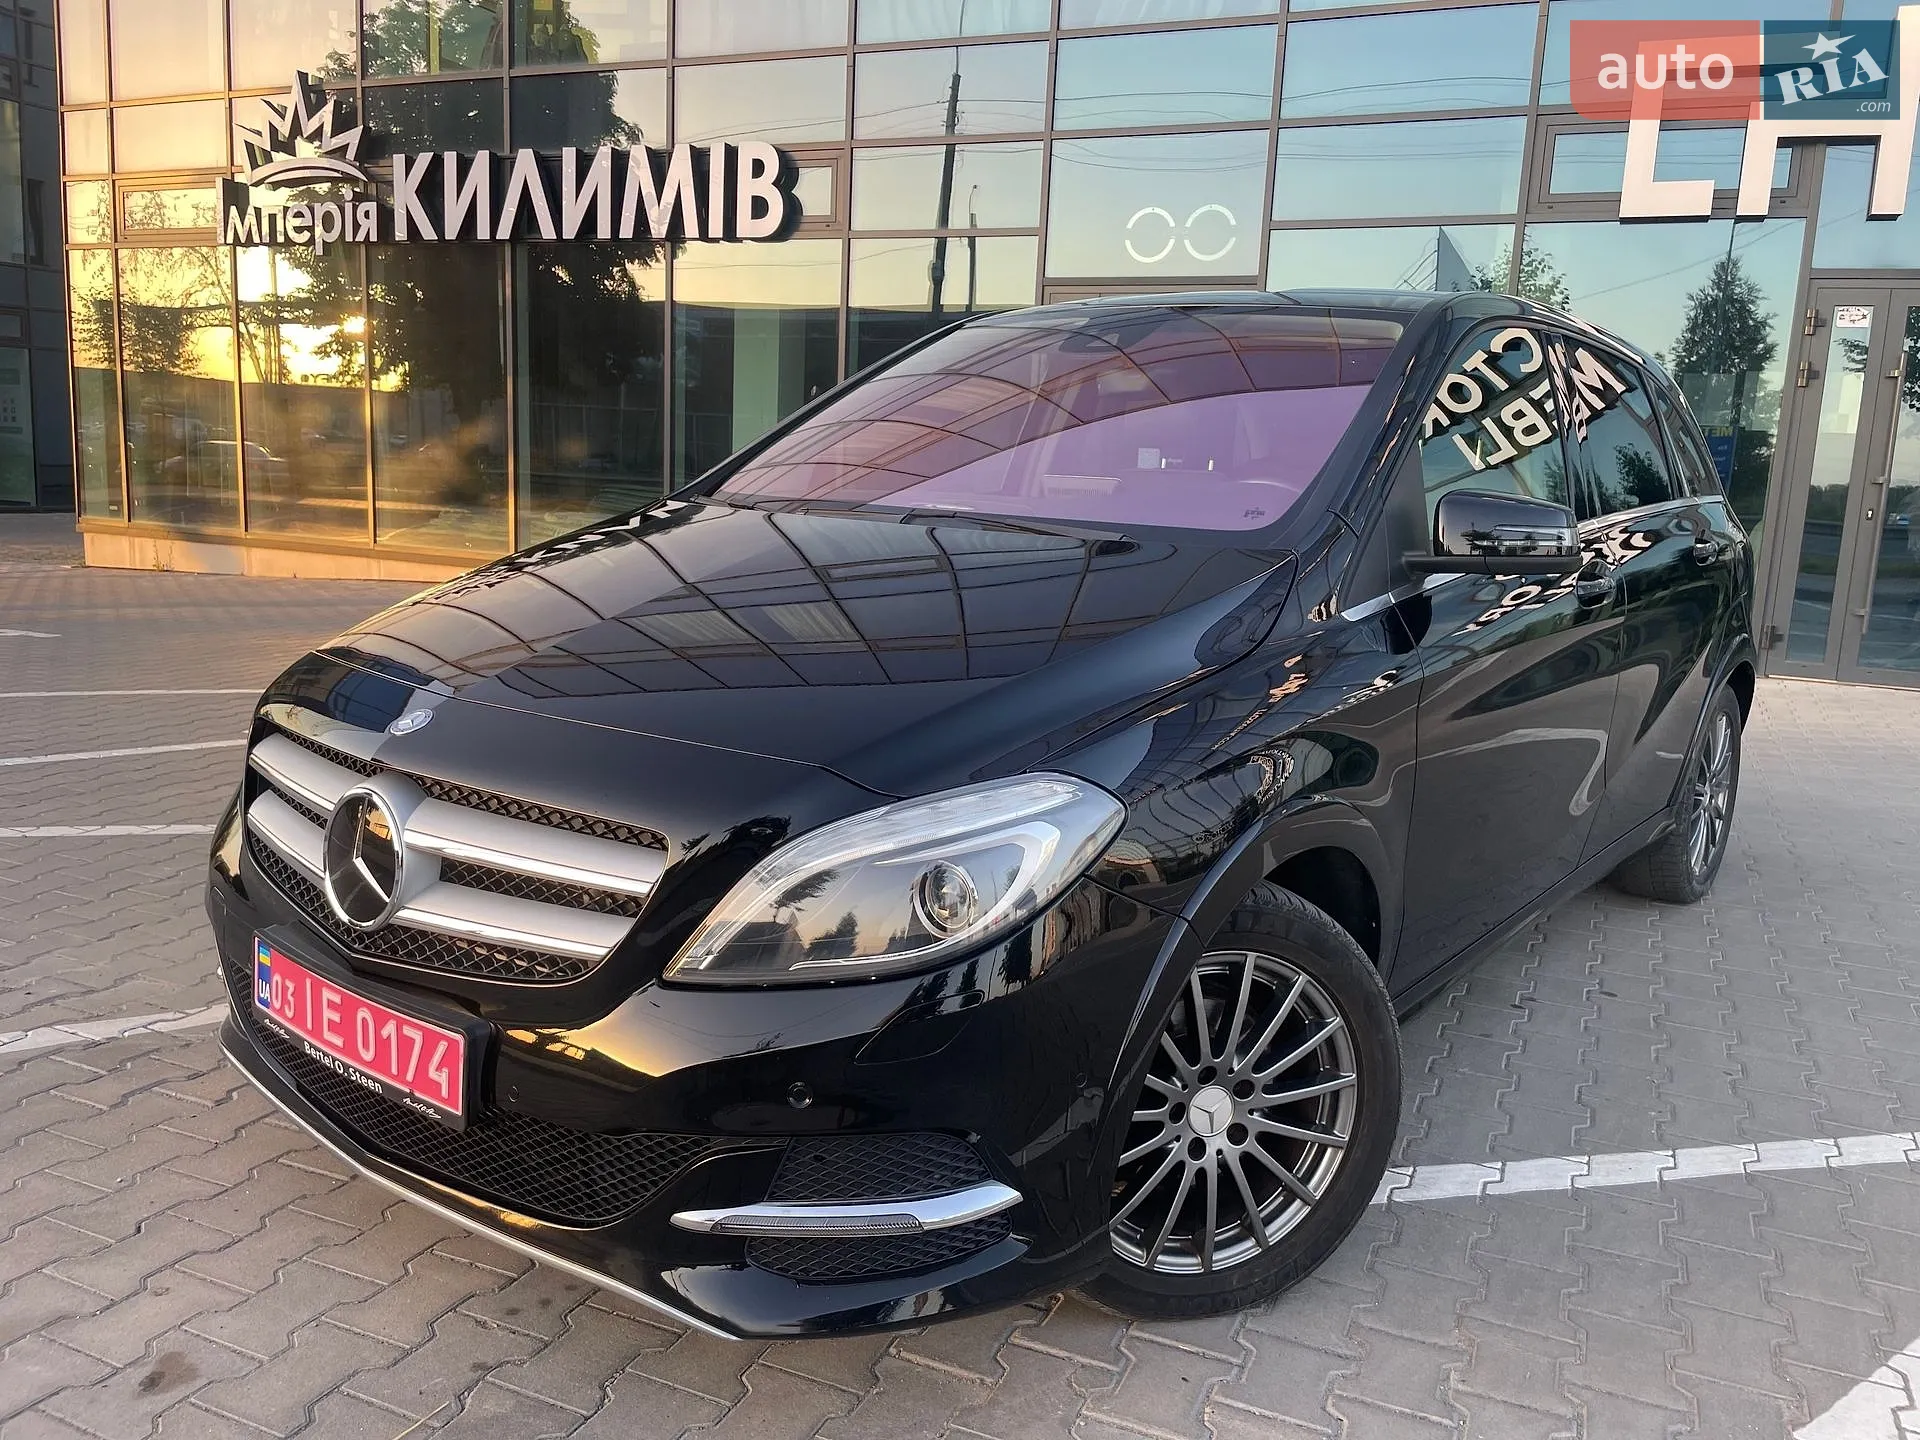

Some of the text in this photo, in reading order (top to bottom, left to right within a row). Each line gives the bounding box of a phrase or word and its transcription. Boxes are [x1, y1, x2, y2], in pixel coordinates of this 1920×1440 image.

[216, 143, 784, 255] Імперія КИЛИМІВ
[259, 979, 271, 1002] UA
[272, 973, 449, 1100] 03 IE 0174
[304, 1040, 334, 1069] Bertel
[349, 1068, 383, 1094] Steen
